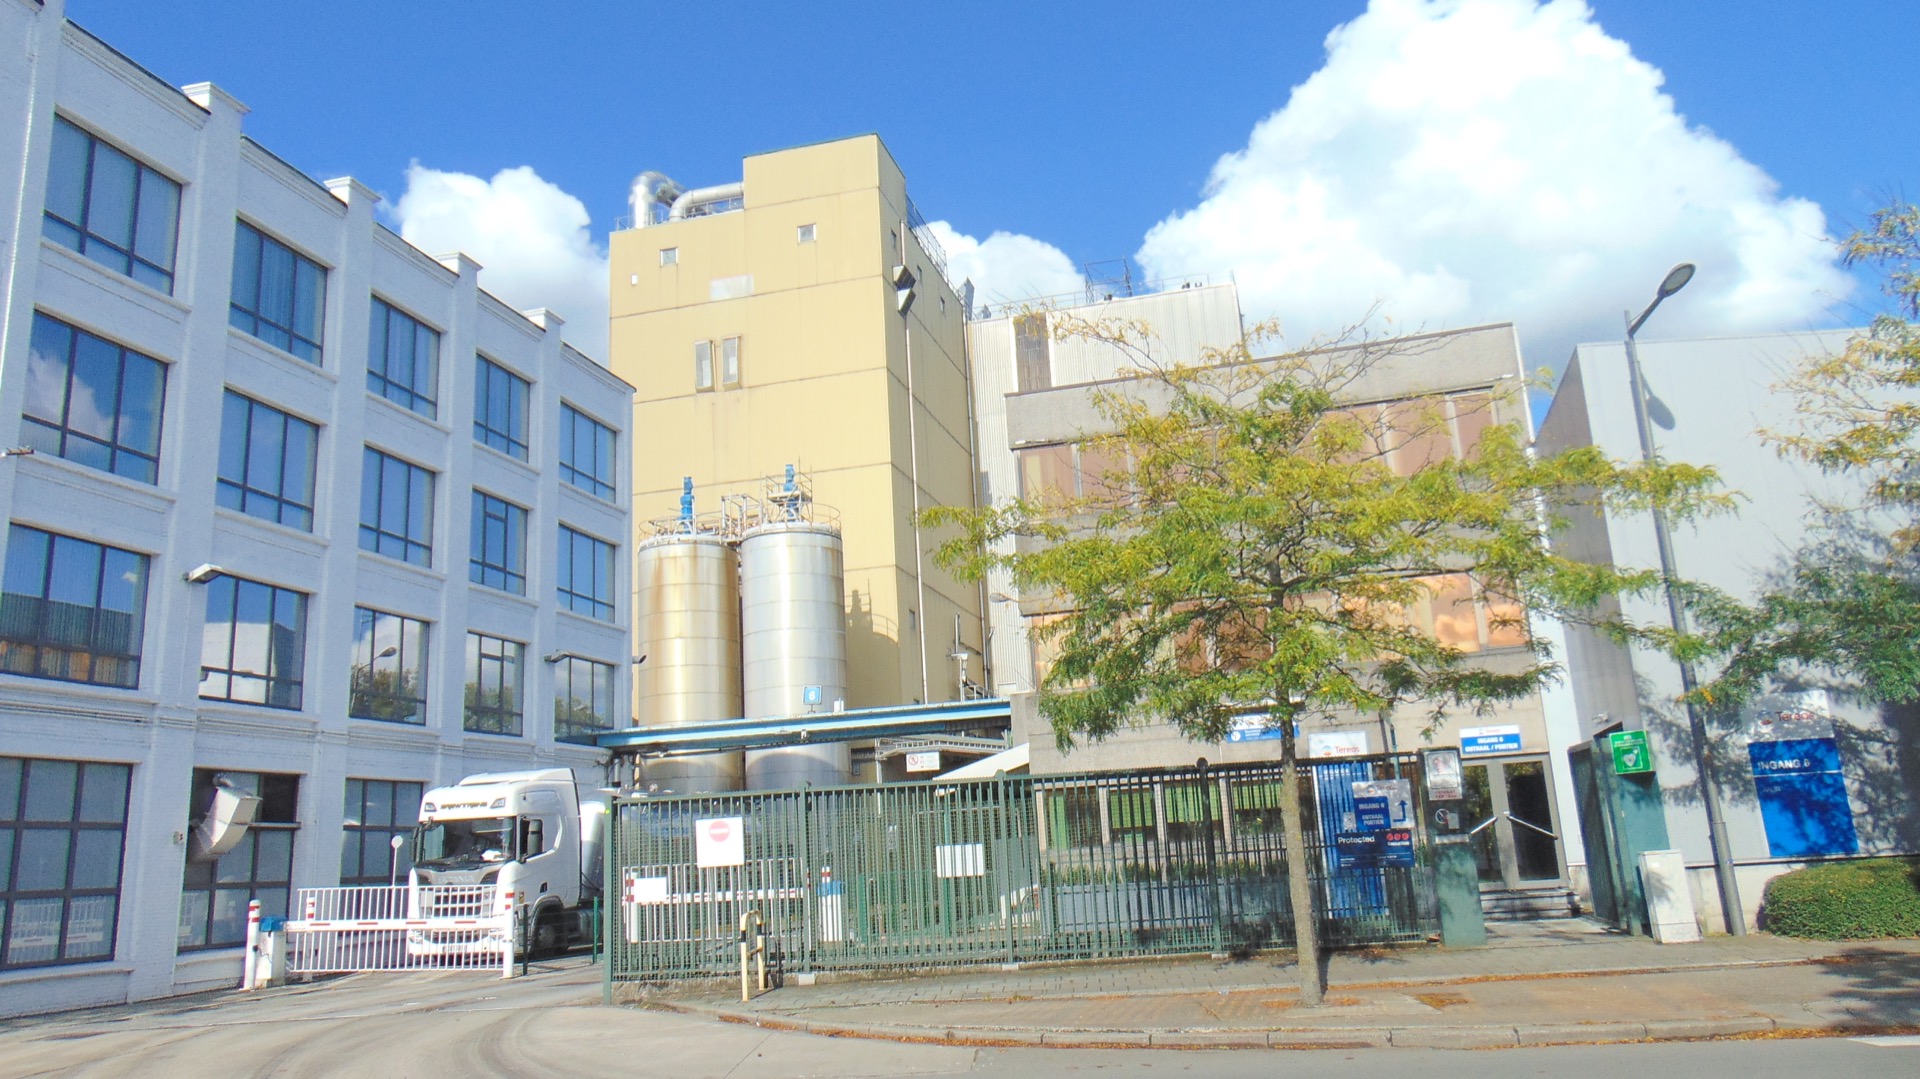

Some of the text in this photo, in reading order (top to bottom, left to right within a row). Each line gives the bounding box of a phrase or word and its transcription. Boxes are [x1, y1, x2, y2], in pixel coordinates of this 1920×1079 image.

[808, 690, 816, 701] 6
[1774, 710, 1815, 722] Tereos
[1334, 745, 1360, 753] Tereos
[1495, 742, 1519, 751] PORTIER
[1757, 758, 1811, 770] INGANG 6
[1337, 834, 1376, 844] Protected
